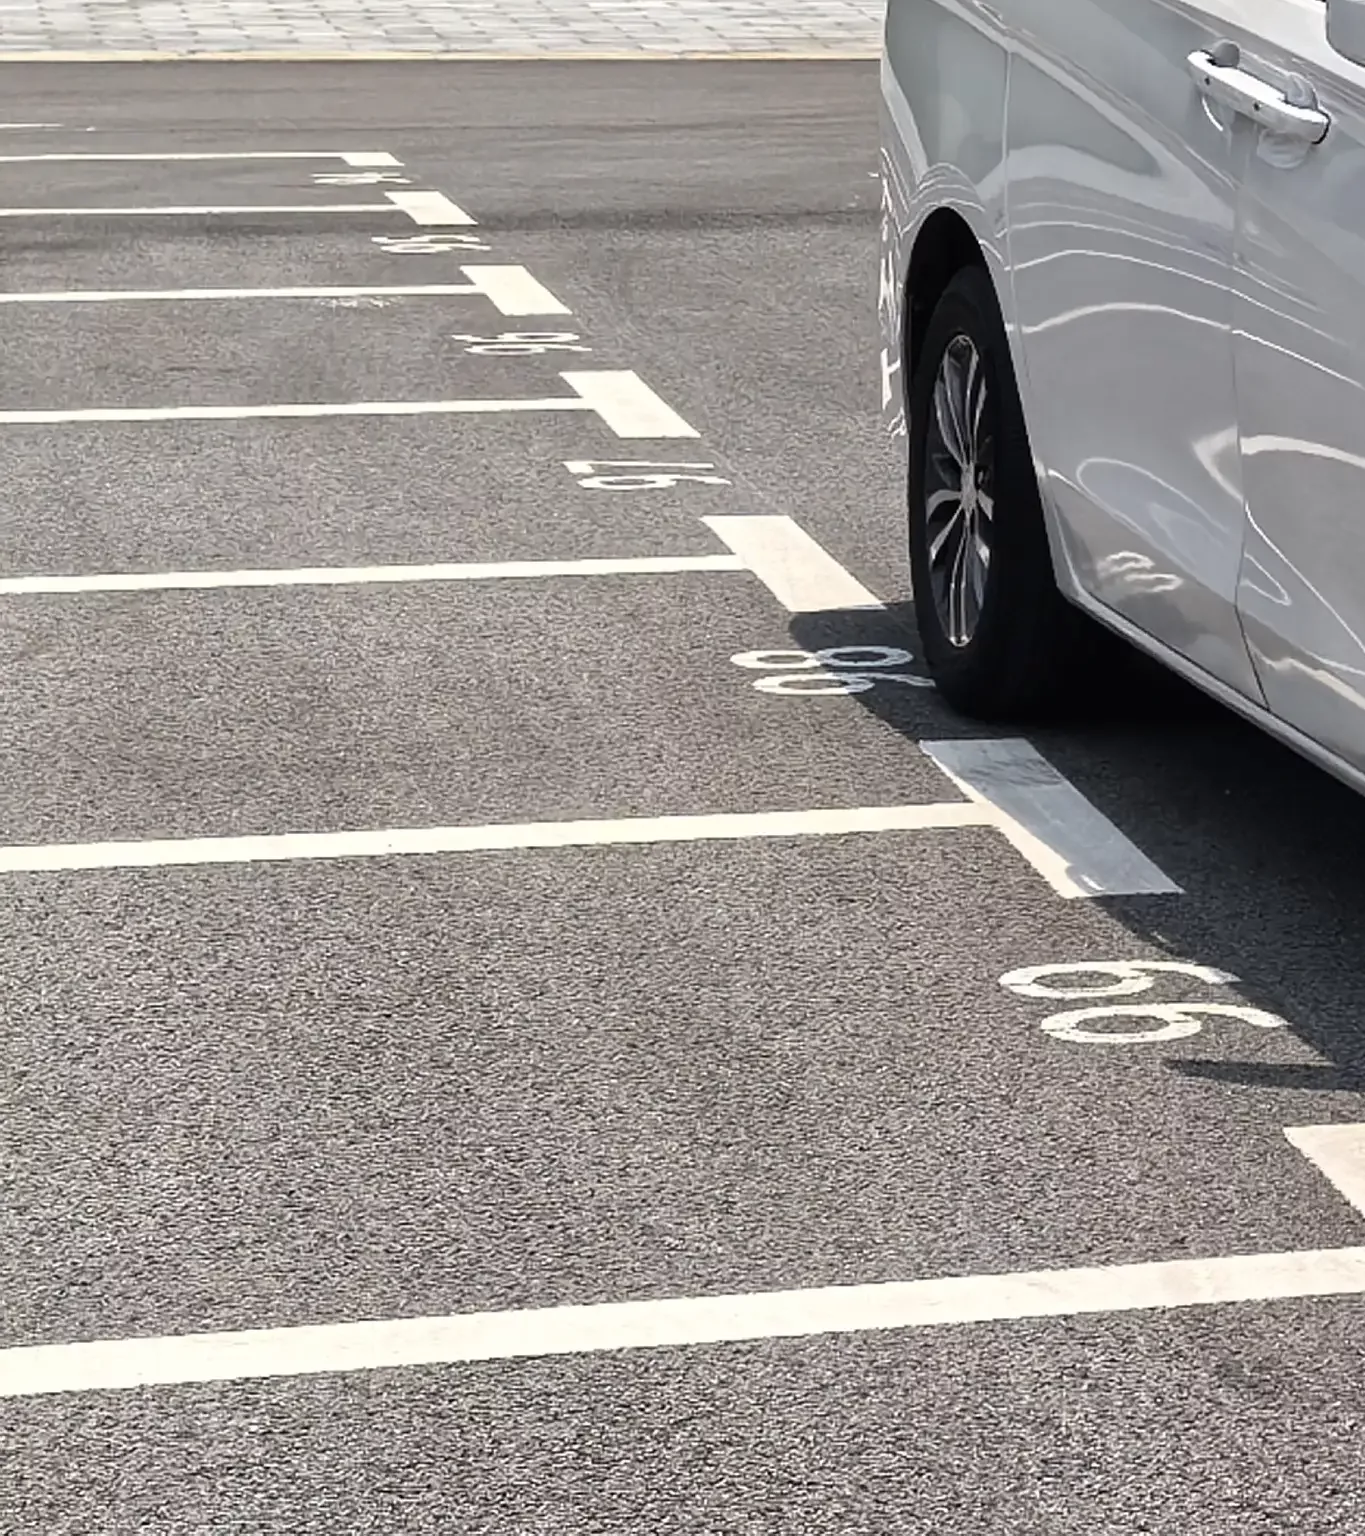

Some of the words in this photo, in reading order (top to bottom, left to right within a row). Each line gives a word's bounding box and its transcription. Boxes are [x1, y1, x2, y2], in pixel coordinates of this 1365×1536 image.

[451, 332, 593, 356] 96
[562, 460, 732, 490] 97
[730, 645, 936, 695] 98
